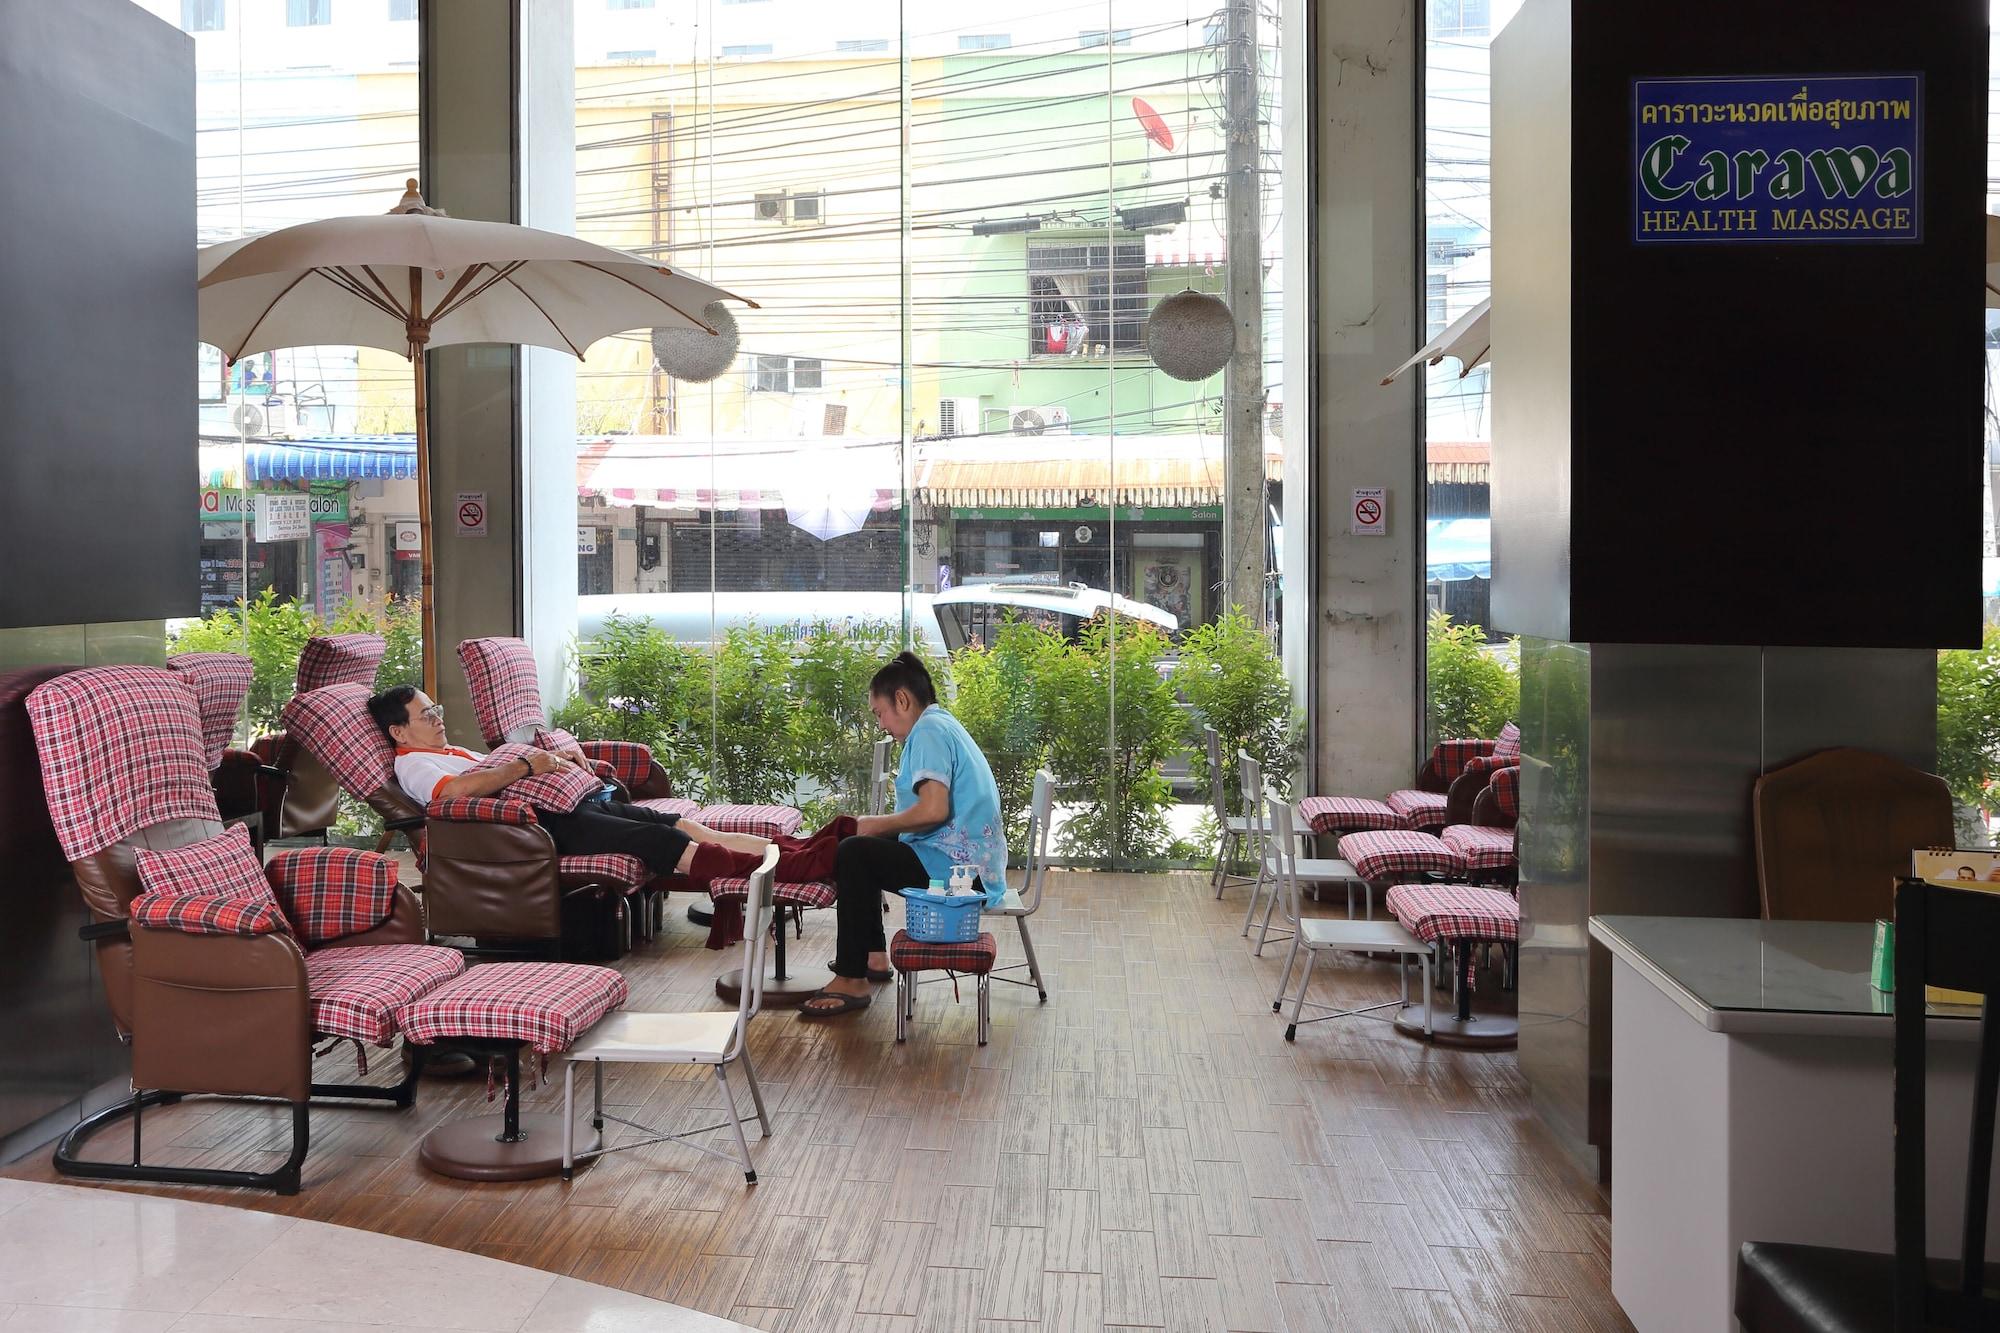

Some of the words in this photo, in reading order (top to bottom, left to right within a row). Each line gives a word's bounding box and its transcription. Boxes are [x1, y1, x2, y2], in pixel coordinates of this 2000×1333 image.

[1642, 86, 1910, 129] คาราวะนวดเพื่อสุขภาพ
[1639, 134, 1912, 201] Carawa
[1642, 210, 1757, 232] HEALTH
[1772, 208, 1910, 231] MASSAGE
[310, 496, 339, 512] alon
[1192, 510, 1217, 519] Salon
[578, 544, 594, 552] NG
